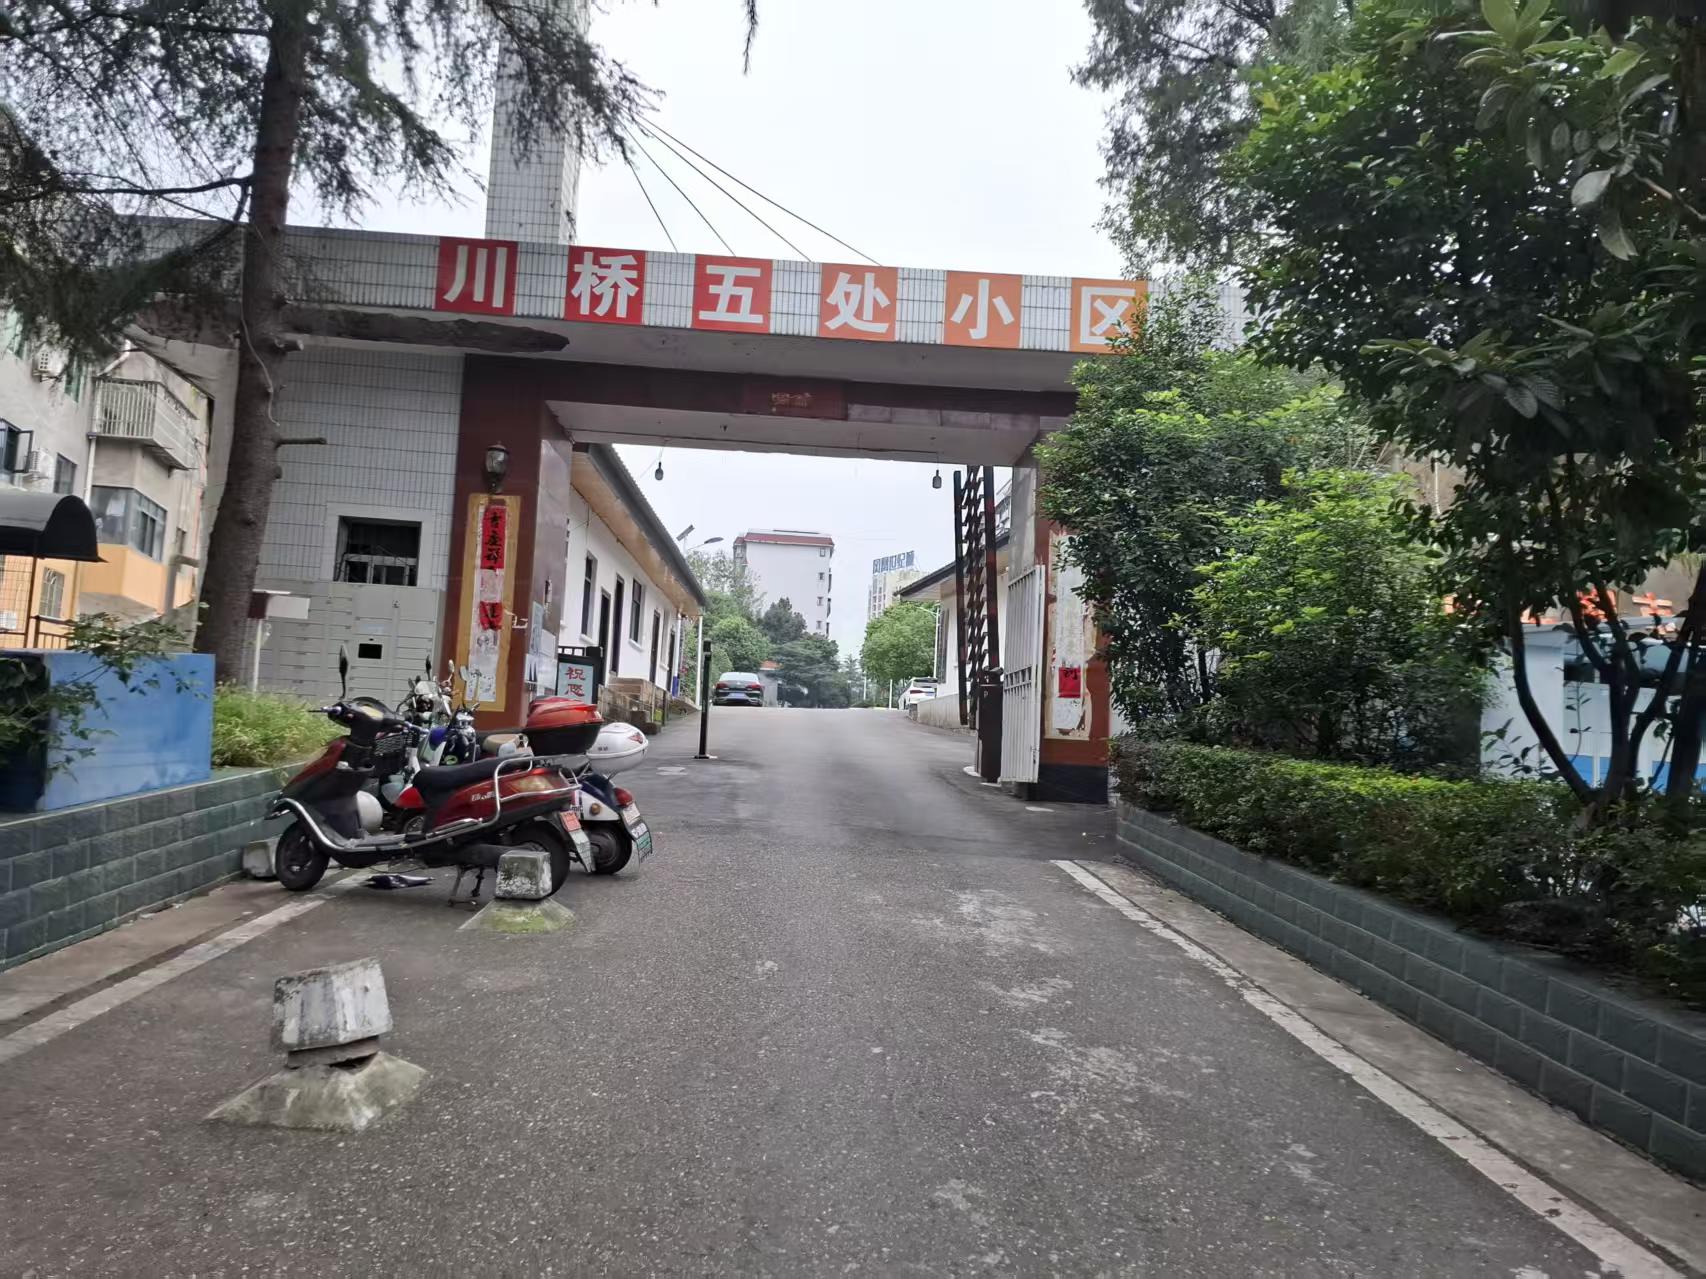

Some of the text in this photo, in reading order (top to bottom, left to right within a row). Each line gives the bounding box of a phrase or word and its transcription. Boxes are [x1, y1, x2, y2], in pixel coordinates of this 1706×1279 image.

[443, 245, 1136, 345] 川桥五处小区
